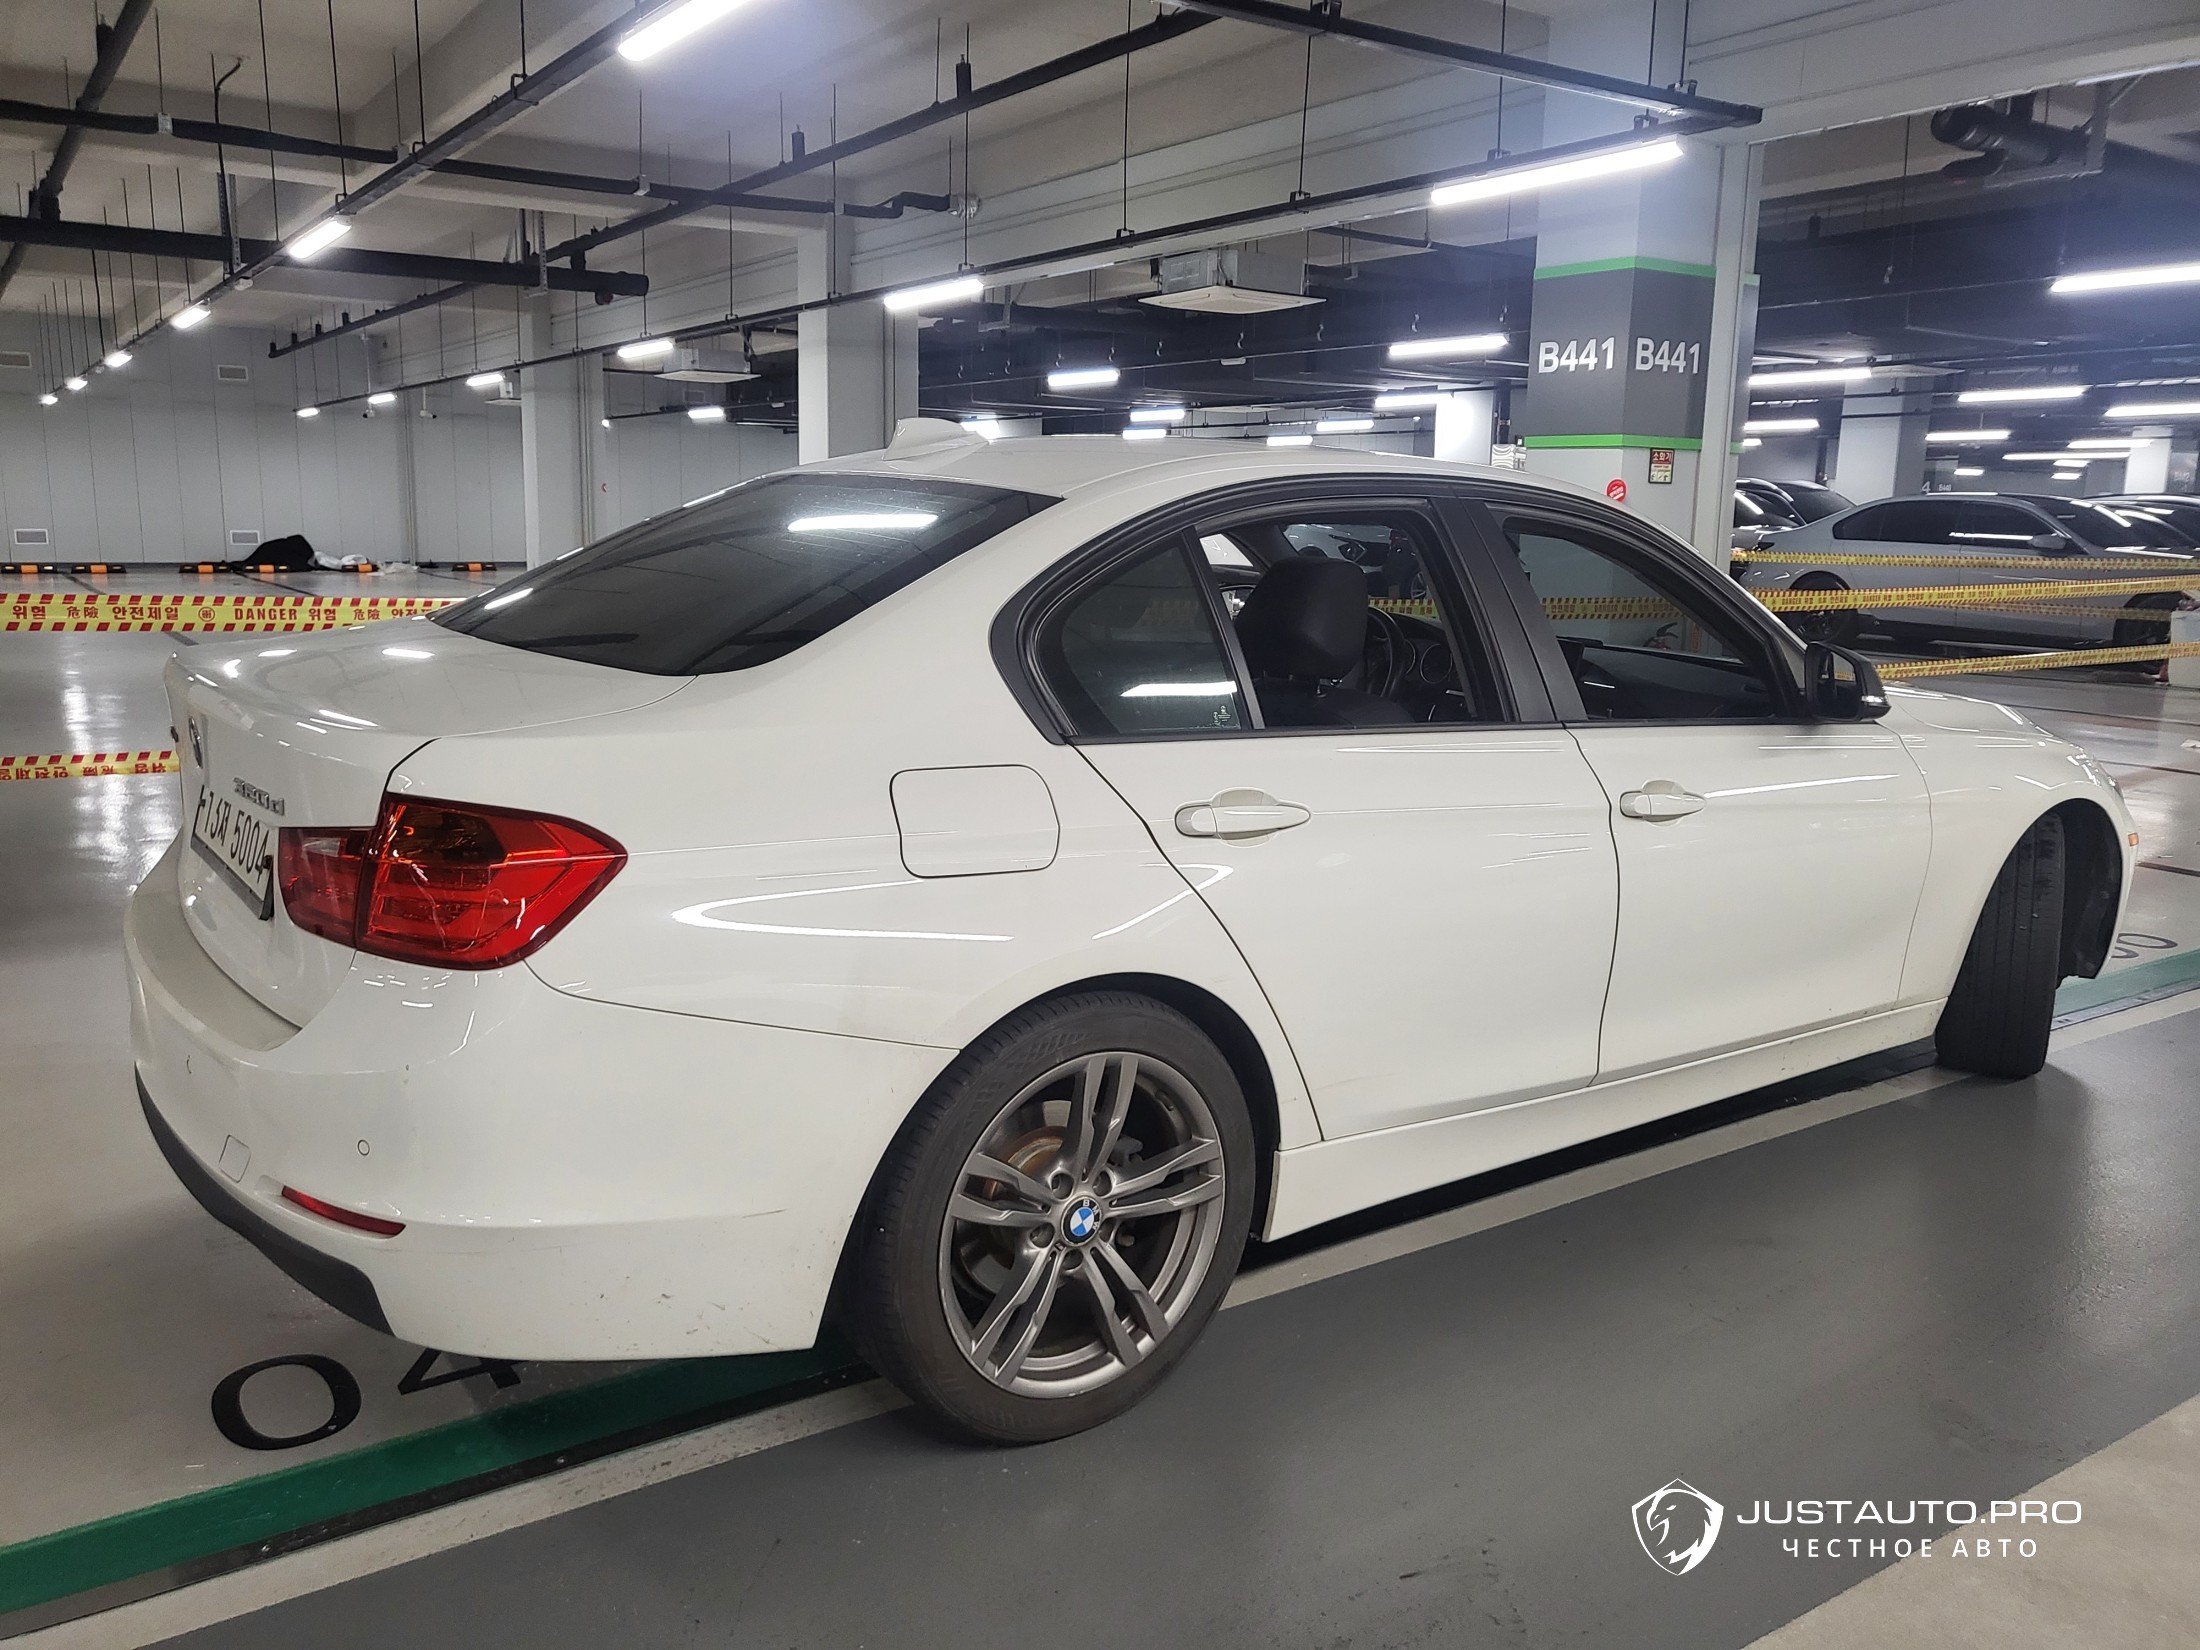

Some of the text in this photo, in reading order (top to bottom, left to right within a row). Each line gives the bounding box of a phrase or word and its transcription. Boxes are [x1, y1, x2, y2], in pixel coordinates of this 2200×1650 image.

[1538, 336, 1615, 374] B441
[1635, 336, 1701, 375] B441
[1652, 452, 1672, 461] 소화기
[12, 605, 47, 620] 위험
[67, 606, 99, 619] 危險
[112, 606, 179, 620] 안전제일
[234, 607, 298, 621] DANGER
[308, 608, 337, 621] 위험
[353, 608, 381, 621] 危險
[230, 809, 270, 884] 5004
[1082, 1199, 1101, 1231] BMW
